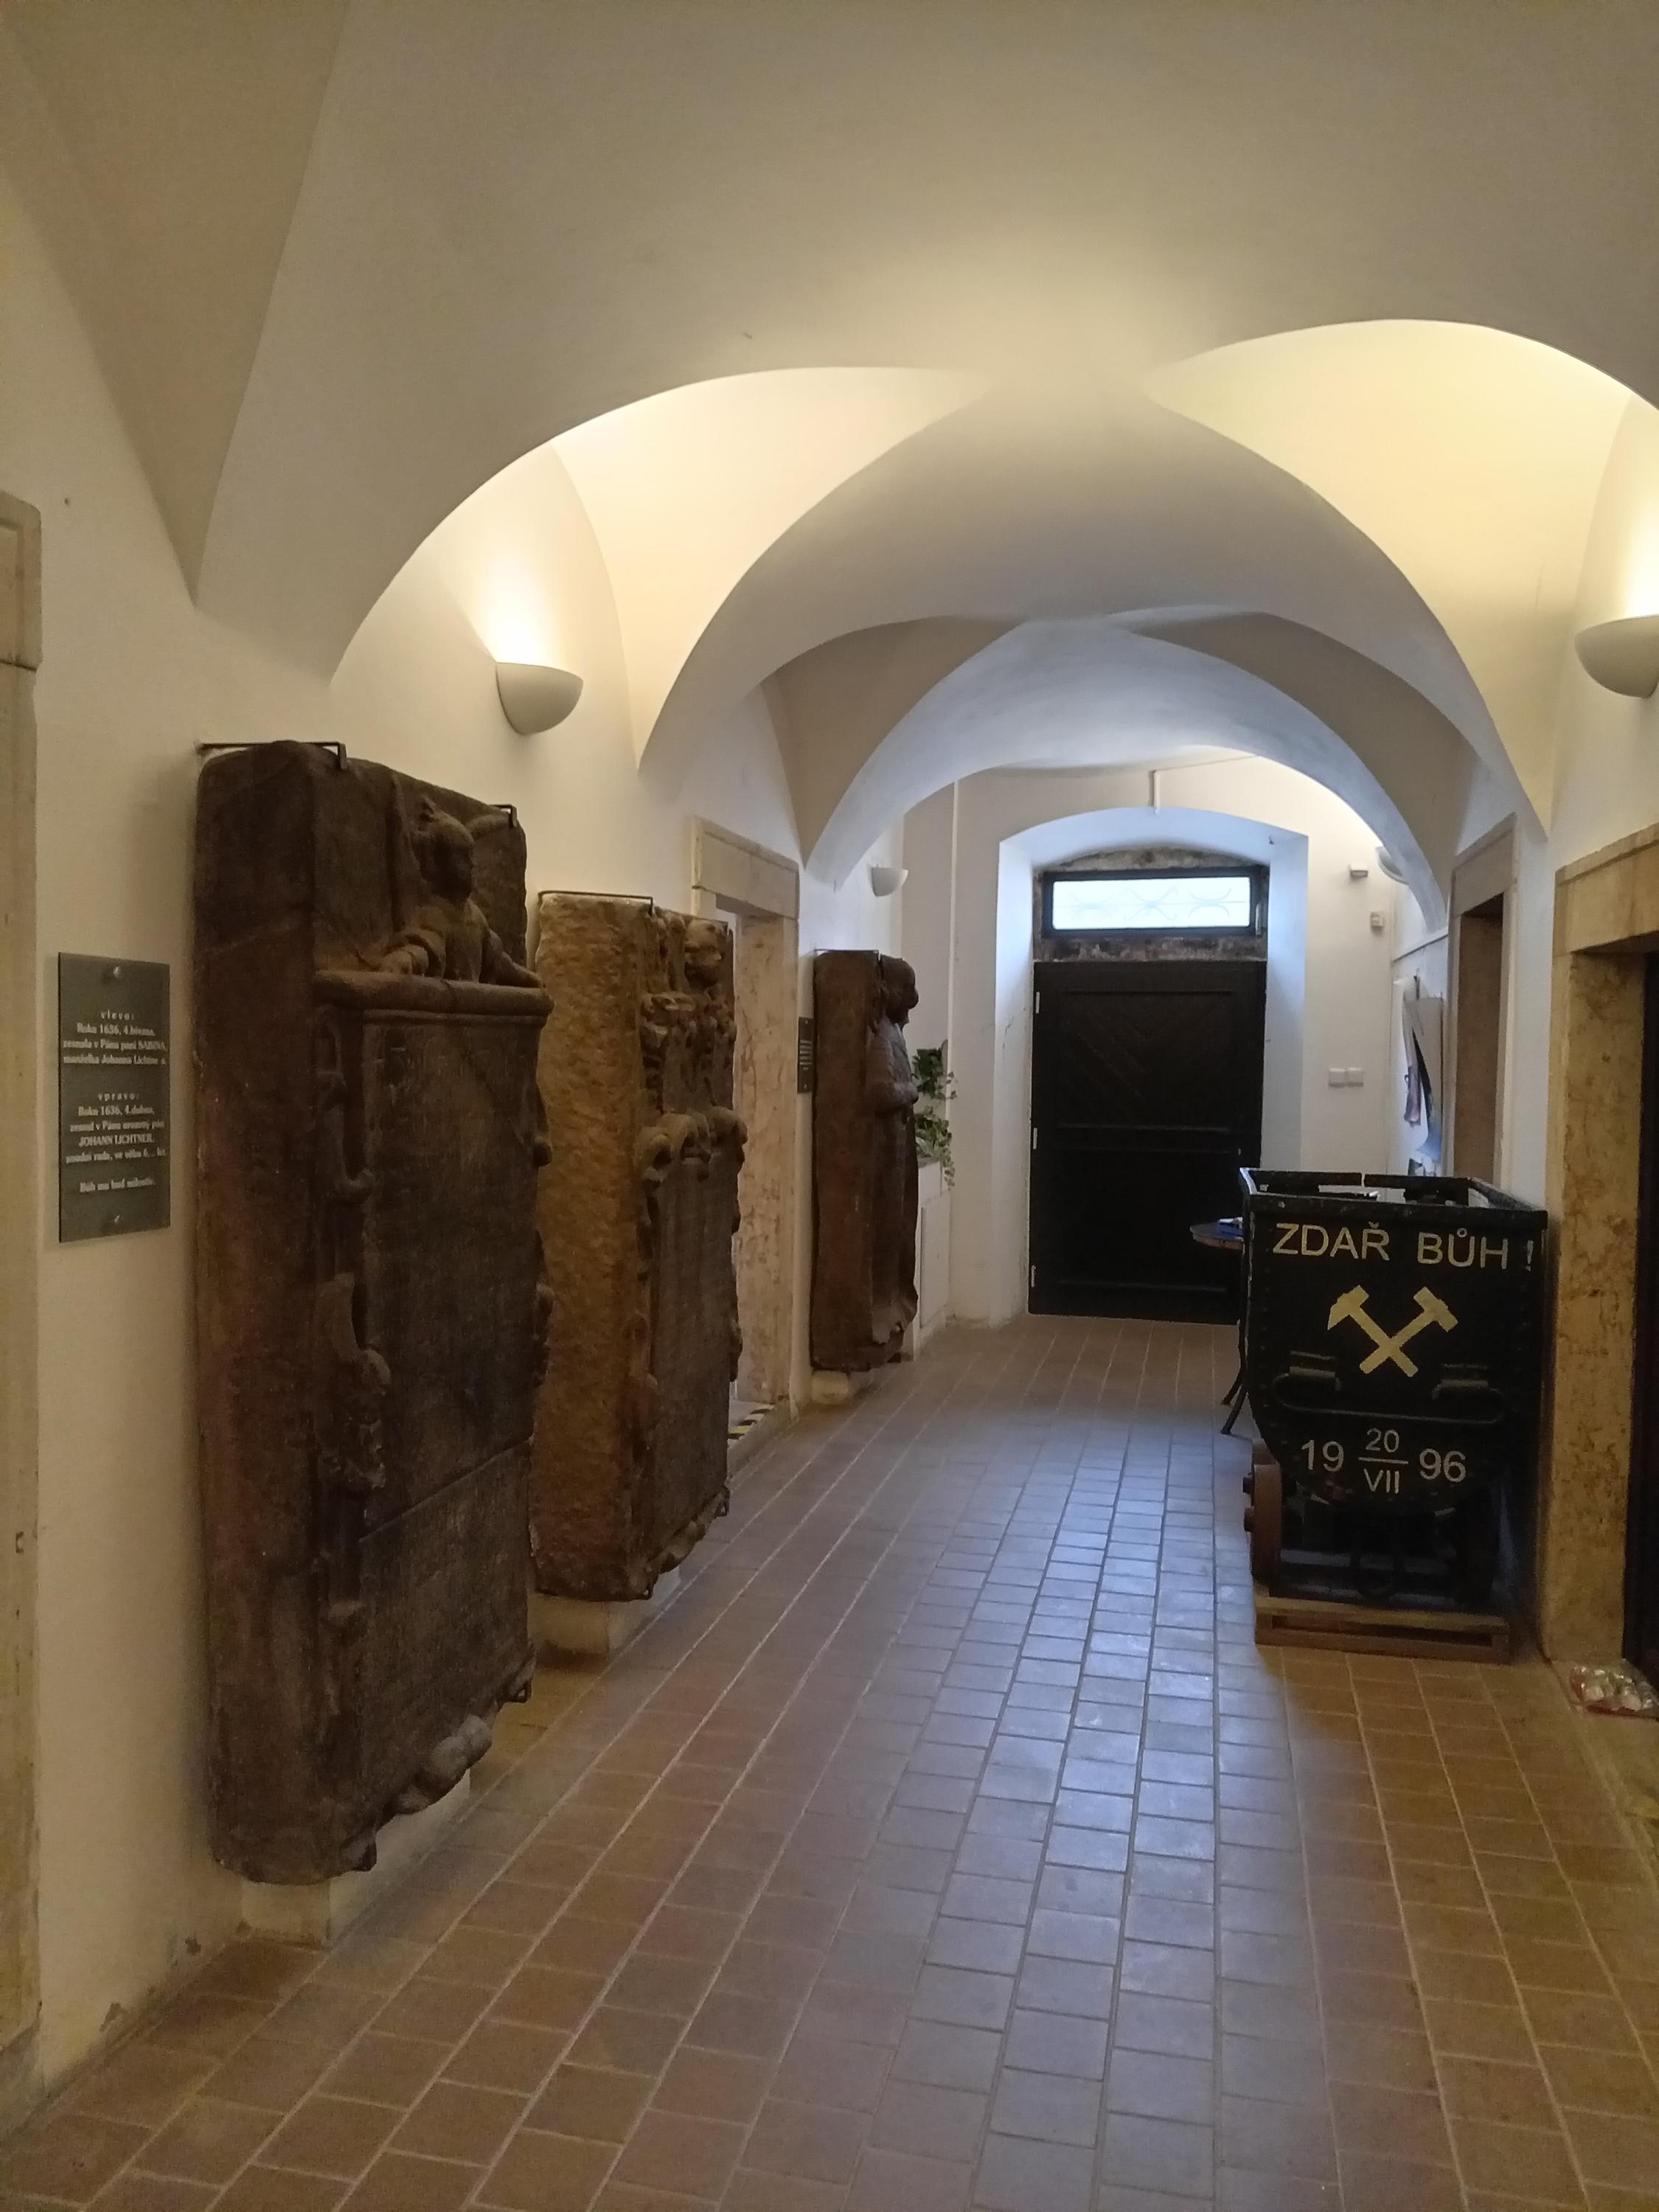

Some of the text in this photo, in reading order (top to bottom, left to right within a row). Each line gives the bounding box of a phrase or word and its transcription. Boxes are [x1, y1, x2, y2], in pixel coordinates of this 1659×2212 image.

[79, 1135, 113, 1147] JOHANN
[1273, 1221, 1391, 1261] ZDAŘ
[1418, 1227, 1509, 1270] BŮH
[1366, 1427, 1399, 1453] 20
[1301, 1439, 1467, 1483] 19 96
[1364, 1468, 1399, 1495] VII
